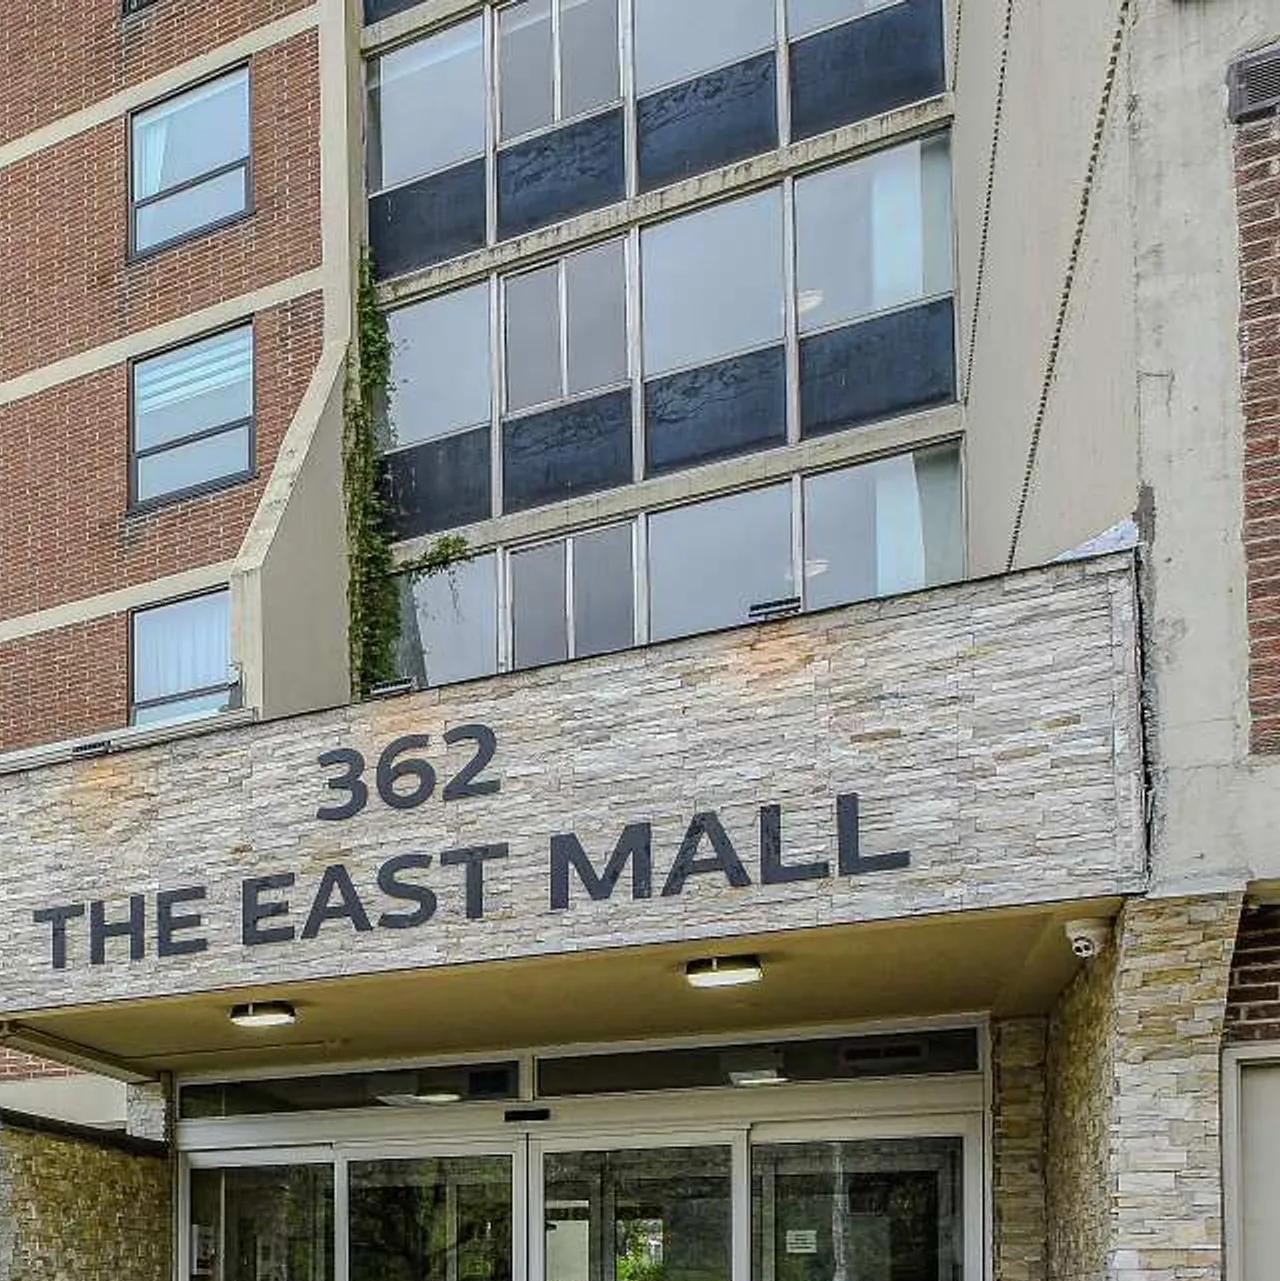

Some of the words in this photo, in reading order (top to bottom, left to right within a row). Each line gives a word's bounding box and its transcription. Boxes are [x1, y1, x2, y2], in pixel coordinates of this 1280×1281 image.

[316, 723, 501, 821] 362
[33, 886, 208, 969] THE
[241, 842, 509, 946] EAST
[550, 792, 911, 910] MALL
